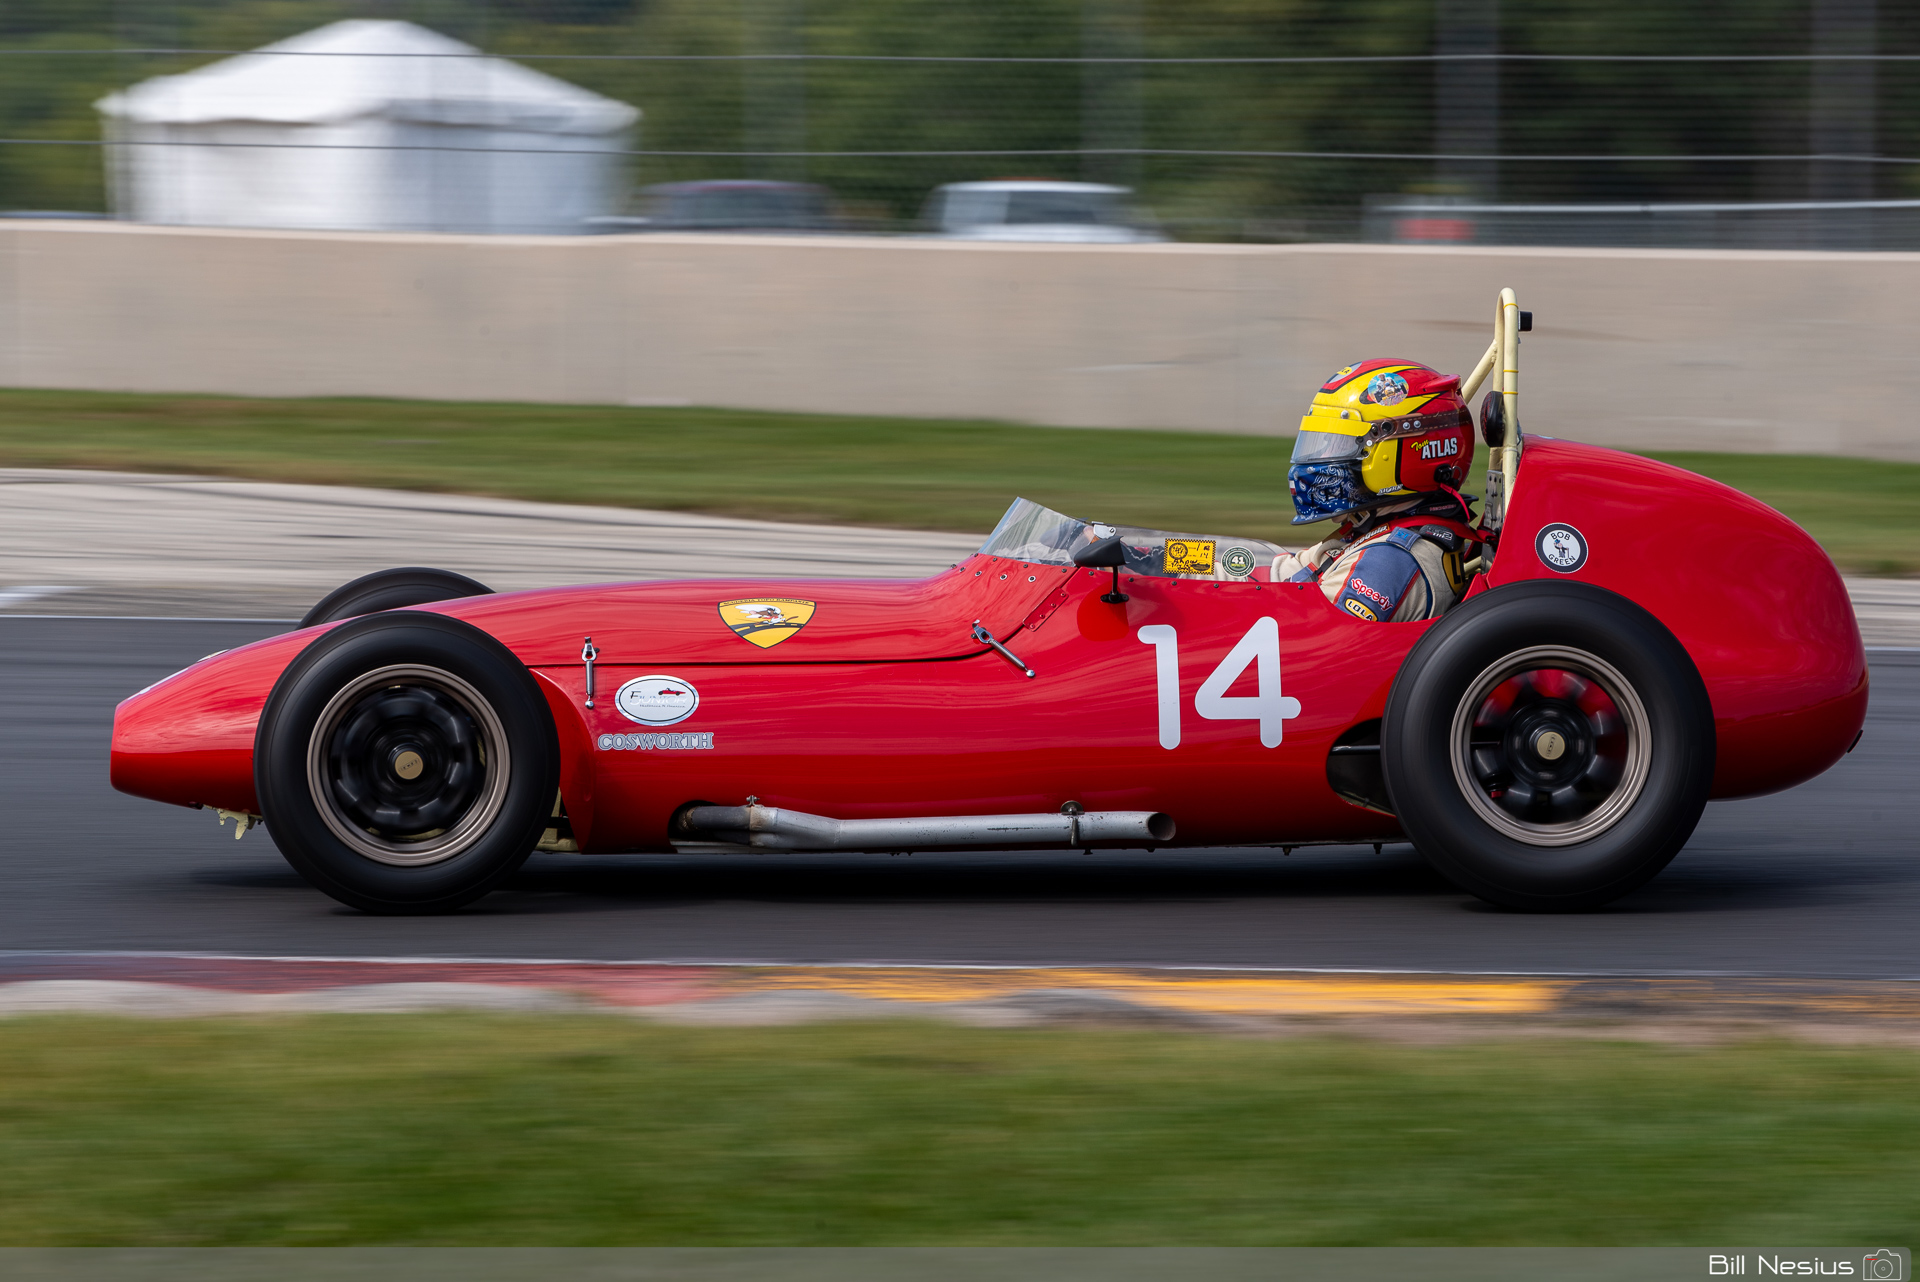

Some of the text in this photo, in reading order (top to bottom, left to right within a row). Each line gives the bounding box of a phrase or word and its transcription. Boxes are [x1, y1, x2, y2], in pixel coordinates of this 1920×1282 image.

[1410, 436, 1458, 460] Tom ATLAS
[1550, 531, 1571, 541] BOB
[1231, 555, 1245, 565] 41
[1548, 553, 1576, 565] GREEN
[1351, 578, 1394, 612] Speedy
[1347, 600, 1375, 621] LOLA
[1137, 616, 1301, 750] 14
[597, 732, 715, 751] COSWORTH
